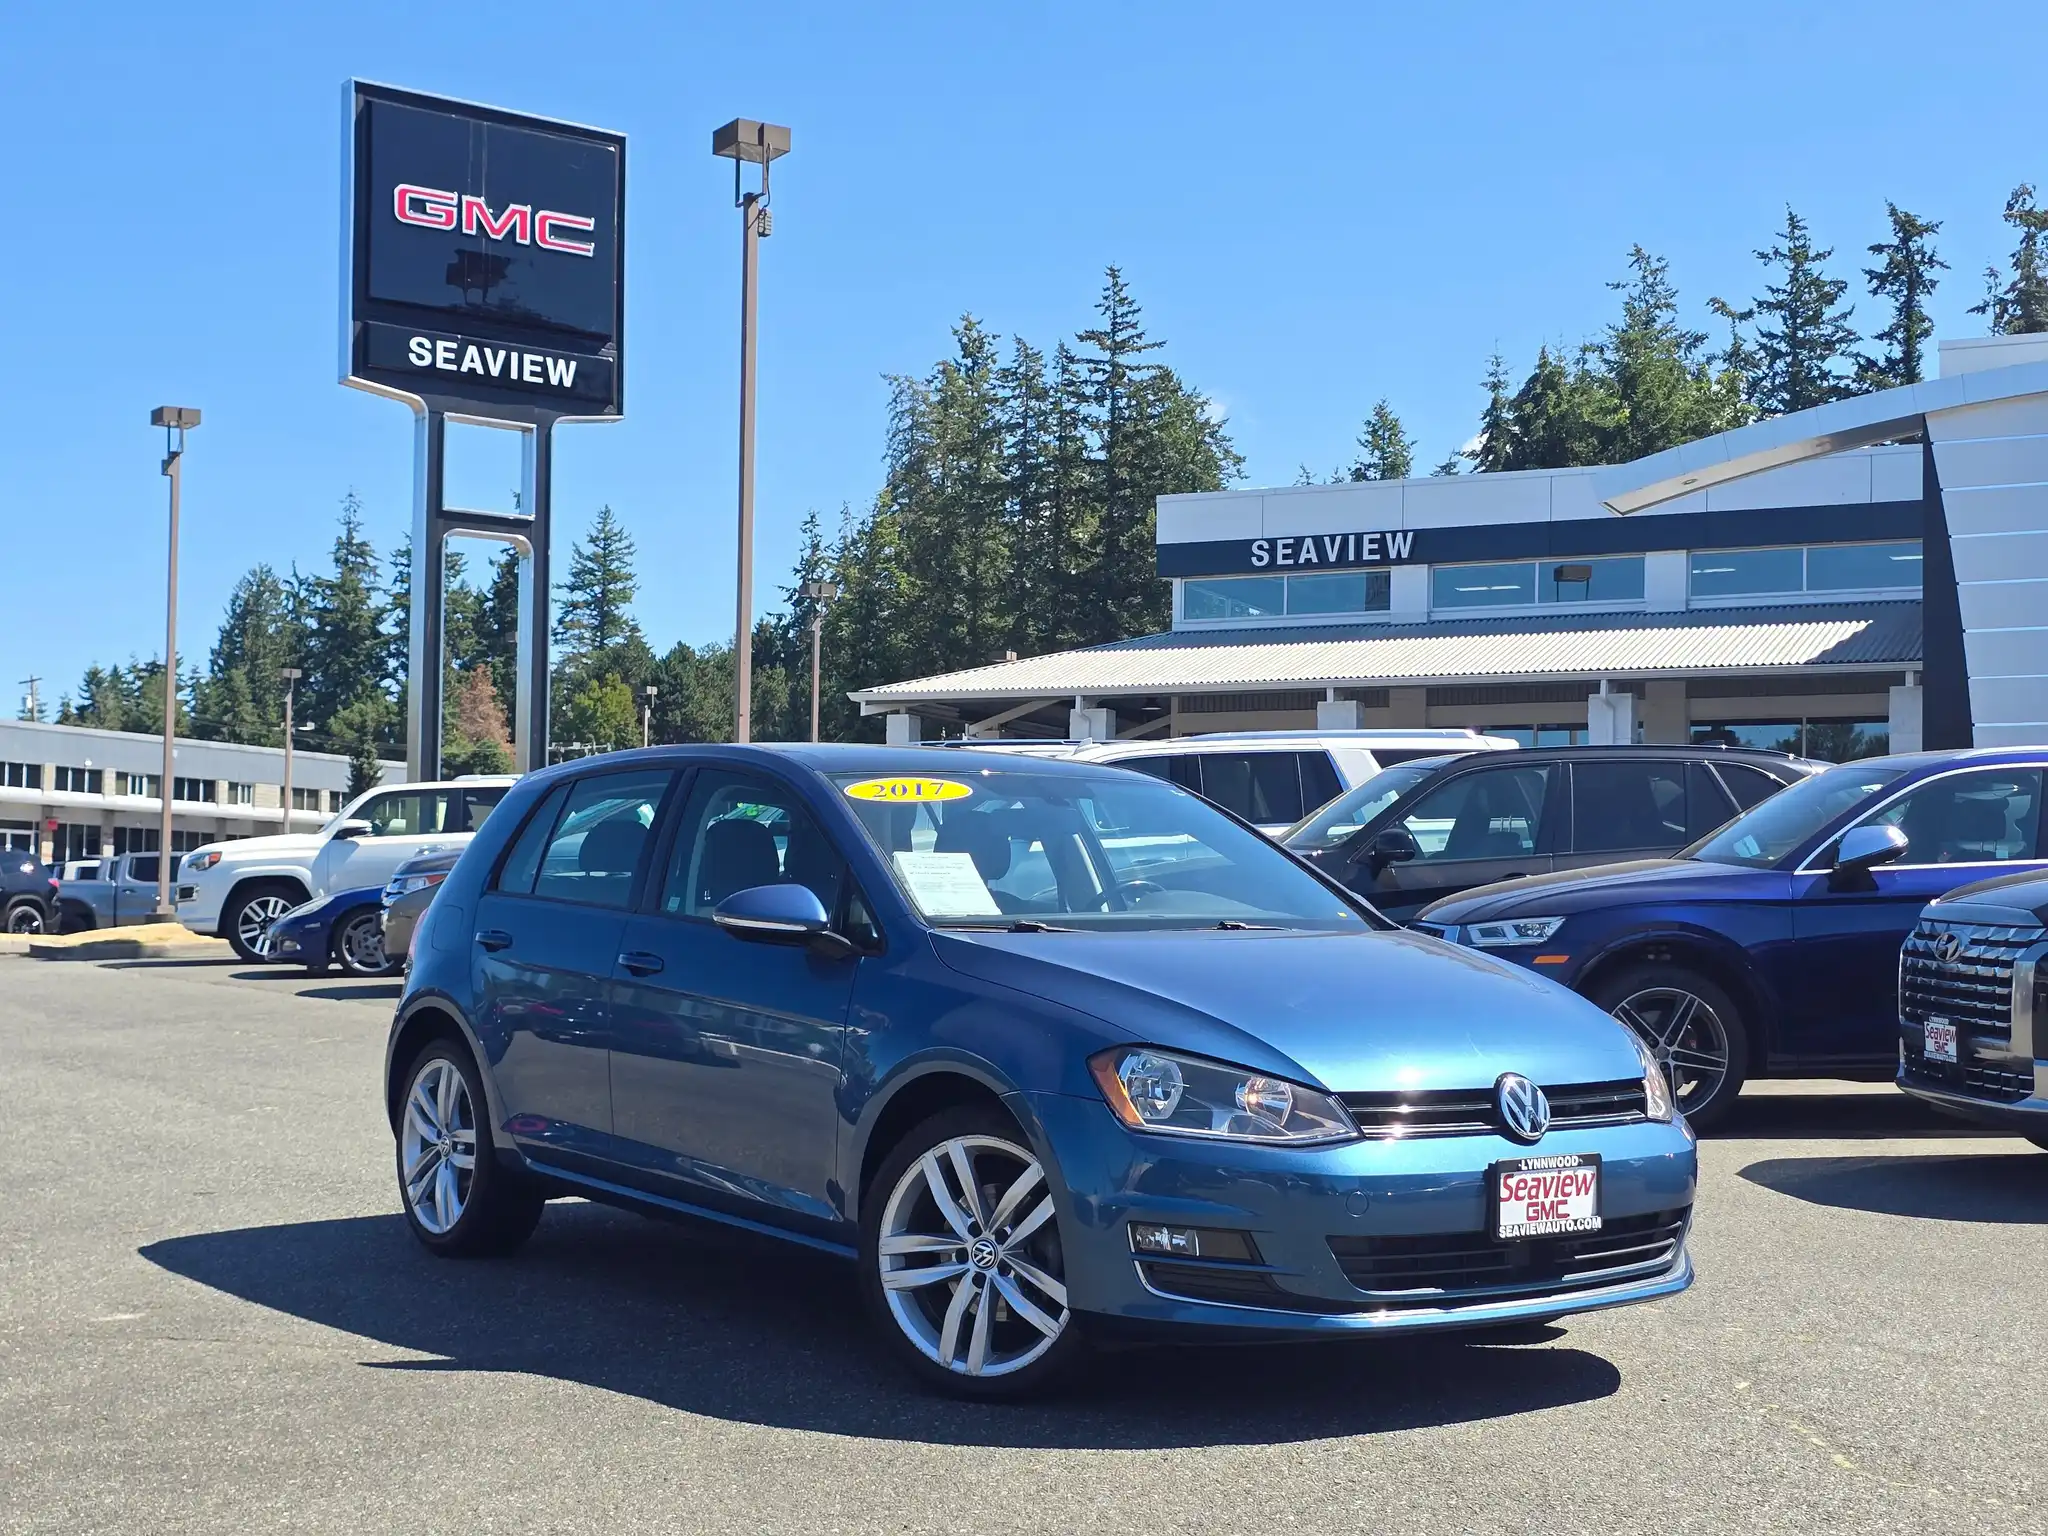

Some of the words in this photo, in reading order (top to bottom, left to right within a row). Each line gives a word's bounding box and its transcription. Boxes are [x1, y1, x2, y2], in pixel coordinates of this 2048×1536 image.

[394, 184, 595, 257] GMC
[408, 336, 577, 388] SEAVIEW
[1251, 532, 1413, 567] SEAVIEW
[871, 782, 945, 798] 2017
[1925, 1023, 1956, 1043] Seaview
[1934, 1040, 1949, 1053] GMC
[1521, 1155, 1579, 1171] LYNNWOOD
[1500, 1169, 1596, 1203] Seaview
[1526, 1199, 1570, 1222] GMC
[1499, 1215, 1602, 1239] SEAVIEWAUTO.COM
